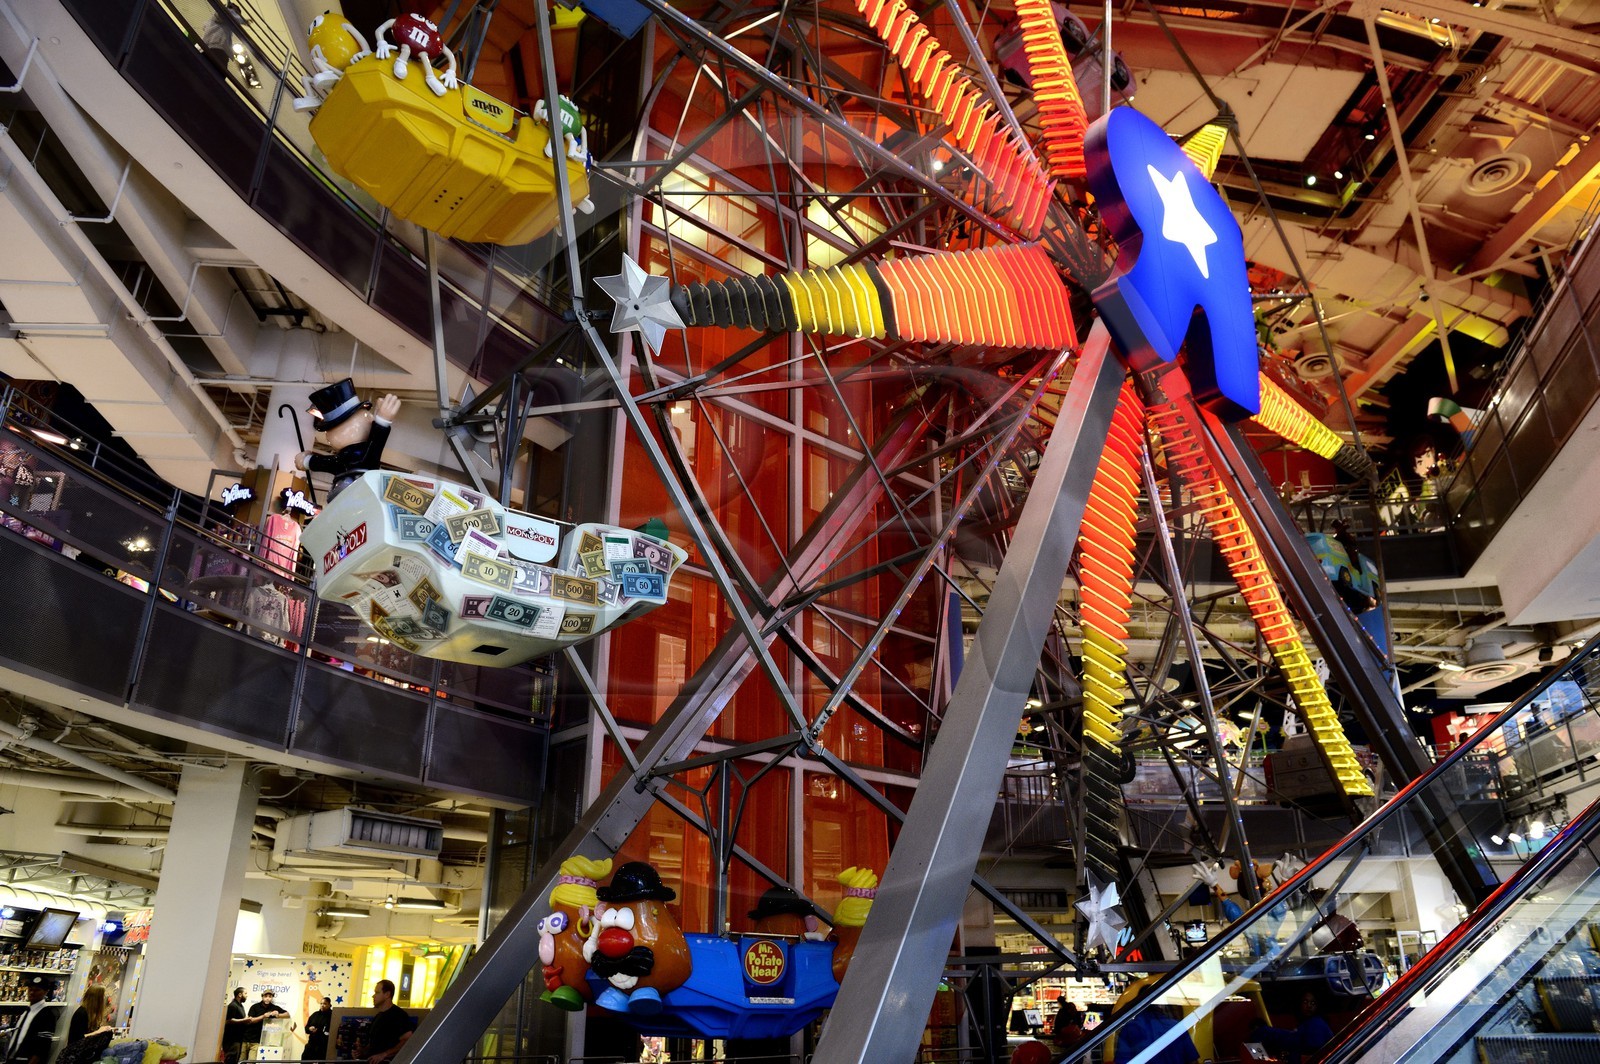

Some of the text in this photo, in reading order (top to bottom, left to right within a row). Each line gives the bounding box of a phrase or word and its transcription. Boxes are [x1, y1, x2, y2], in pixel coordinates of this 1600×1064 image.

[409, 26, 430, 48] m
[403, 491, 422, 506] 500
[419, 524, 432, 534] 20
[506, 527, 555, 546] MONOPOLY
[324, 525, 367, 571] MONOPOLY
[650, 550, 655, 559] 5
[483, 566, 494, 577] 10
[566, 584, 583, 595] 500
[639, 581, 649, 590] 50
[507, 607, 520, 618] 20
[564, 619, 579, 628] 100
[758, 943, 773, 954] Mr.
[277, 969, 292, 977] here!
[751, 965, 778, 977] Head
